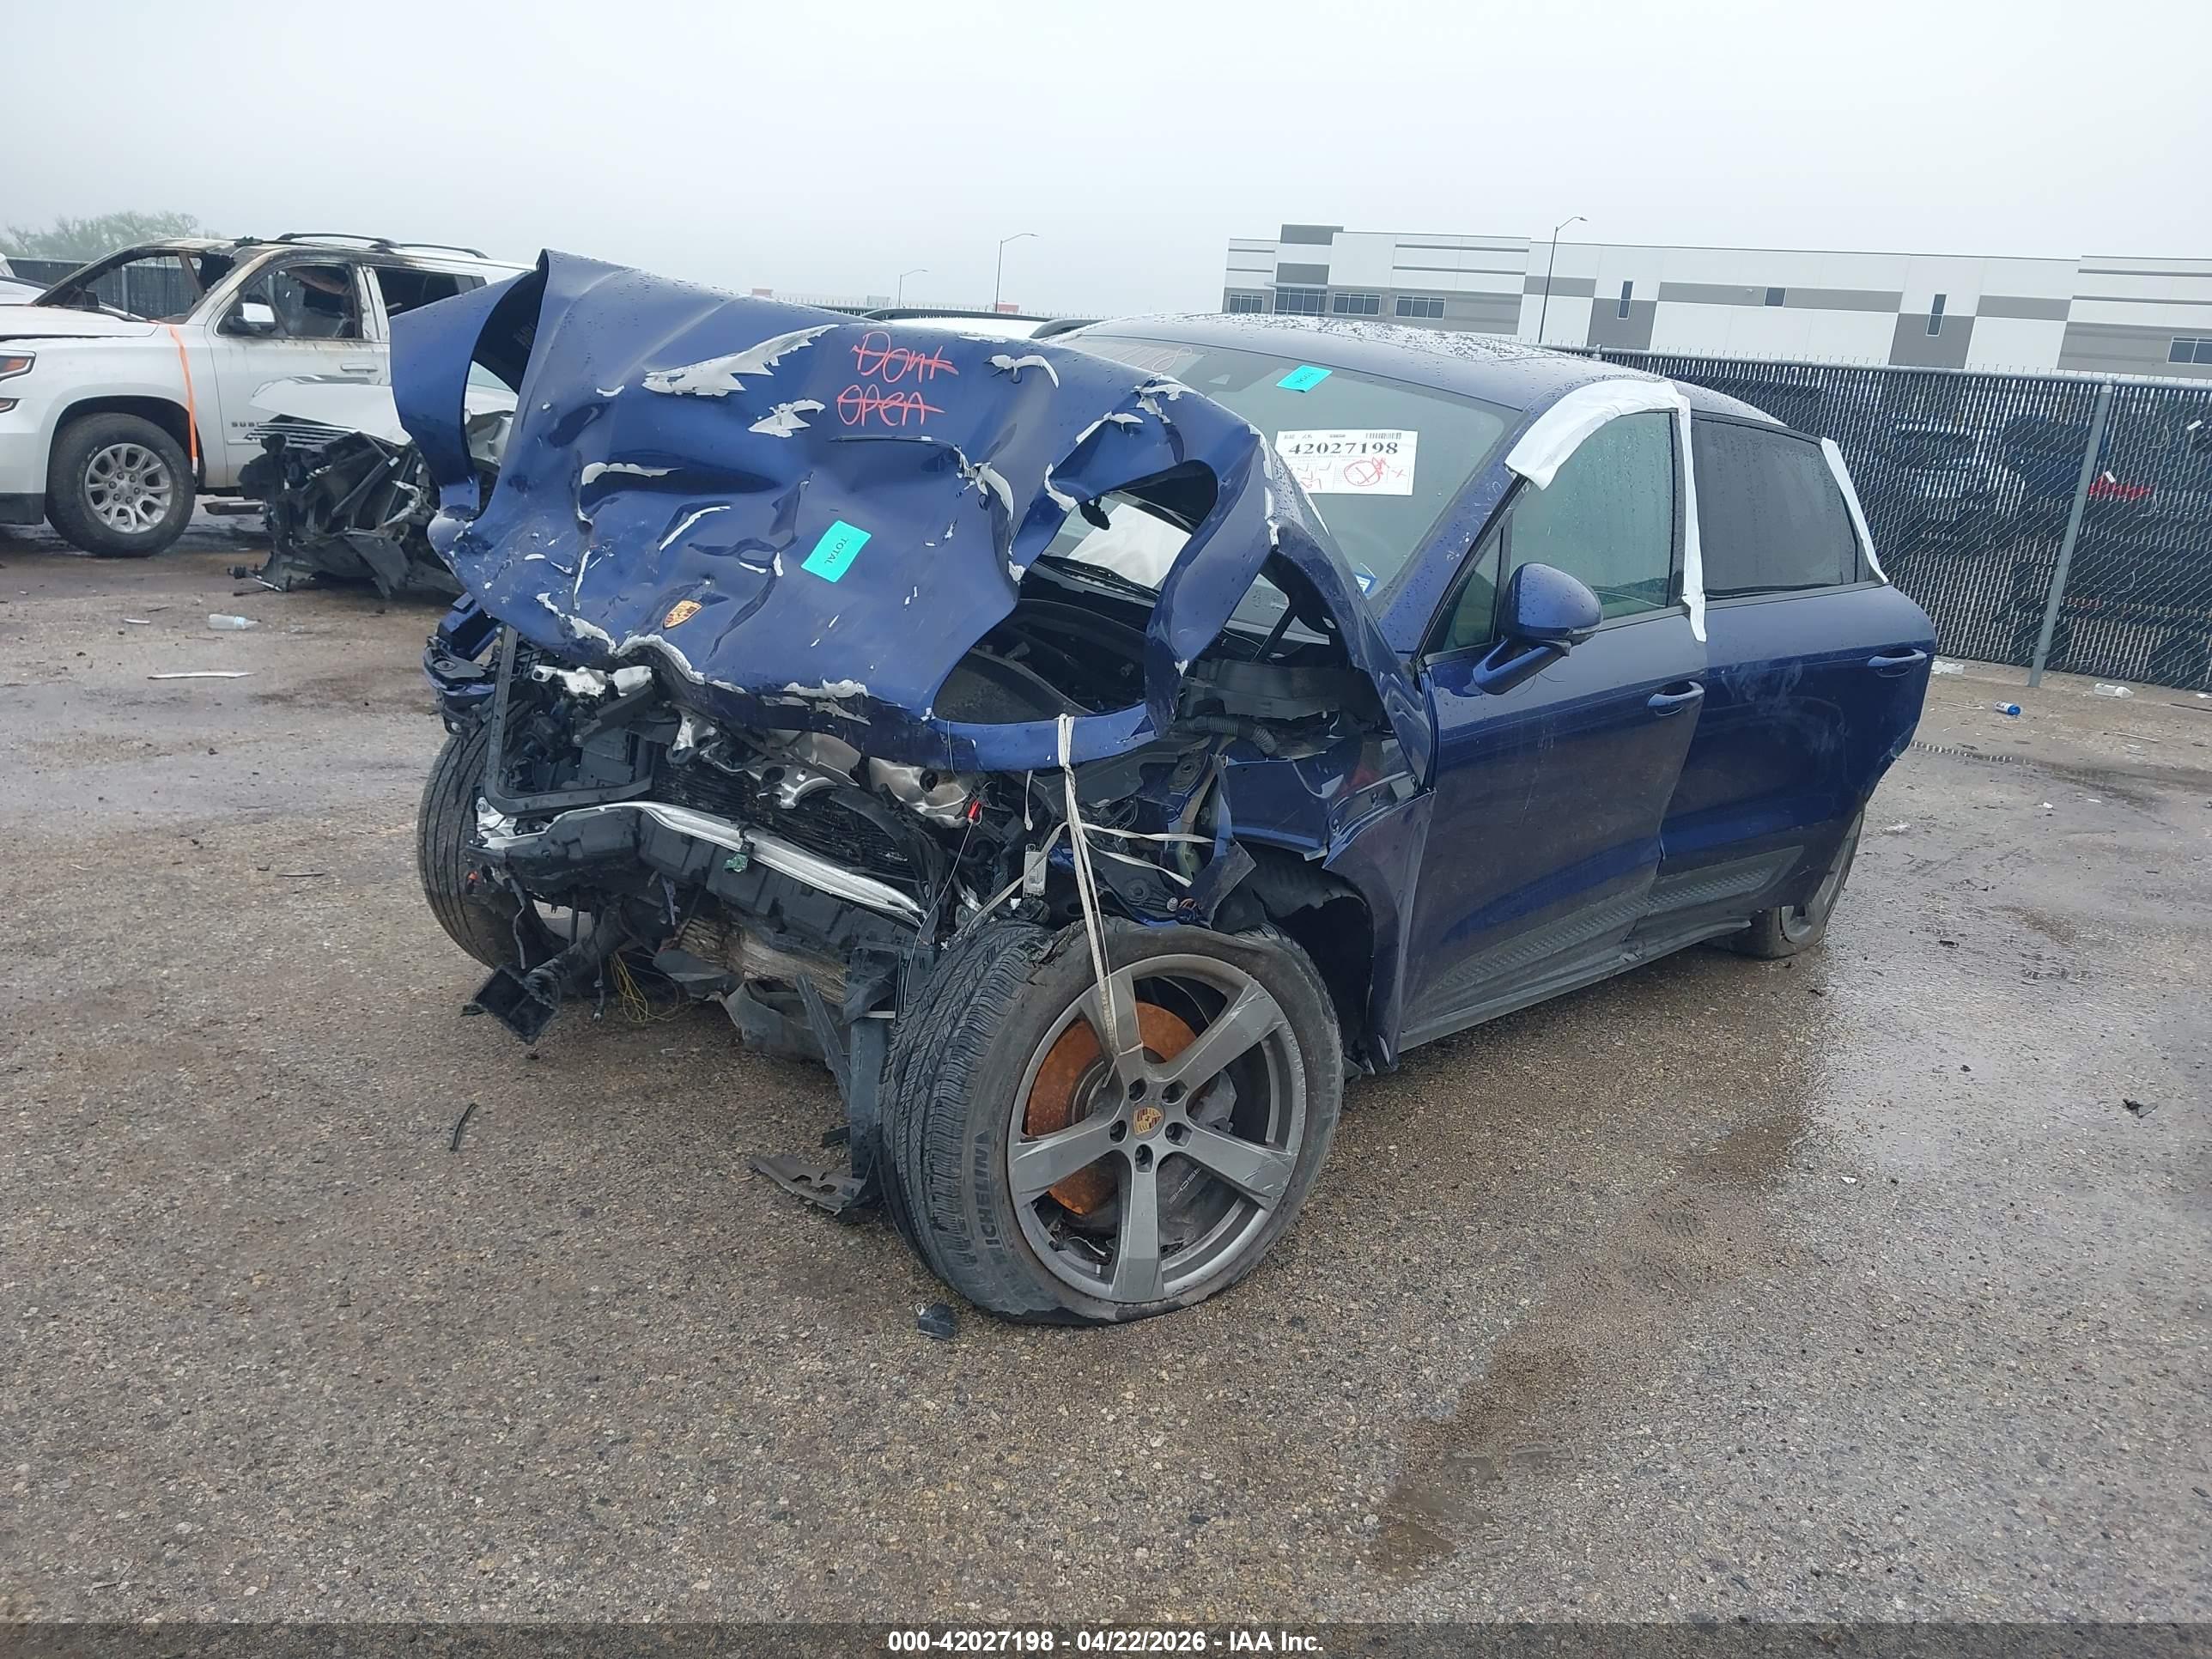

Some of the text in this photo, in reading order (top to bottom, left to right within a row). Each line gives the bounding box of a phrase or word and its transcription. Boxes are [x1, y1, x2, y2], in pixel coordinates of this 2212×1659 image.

[1288, 442, 1399, 454] 42027198
[823, 538, 849, 565] TOTAL
[975, 1147, 1004, 1252] ICHELIN
